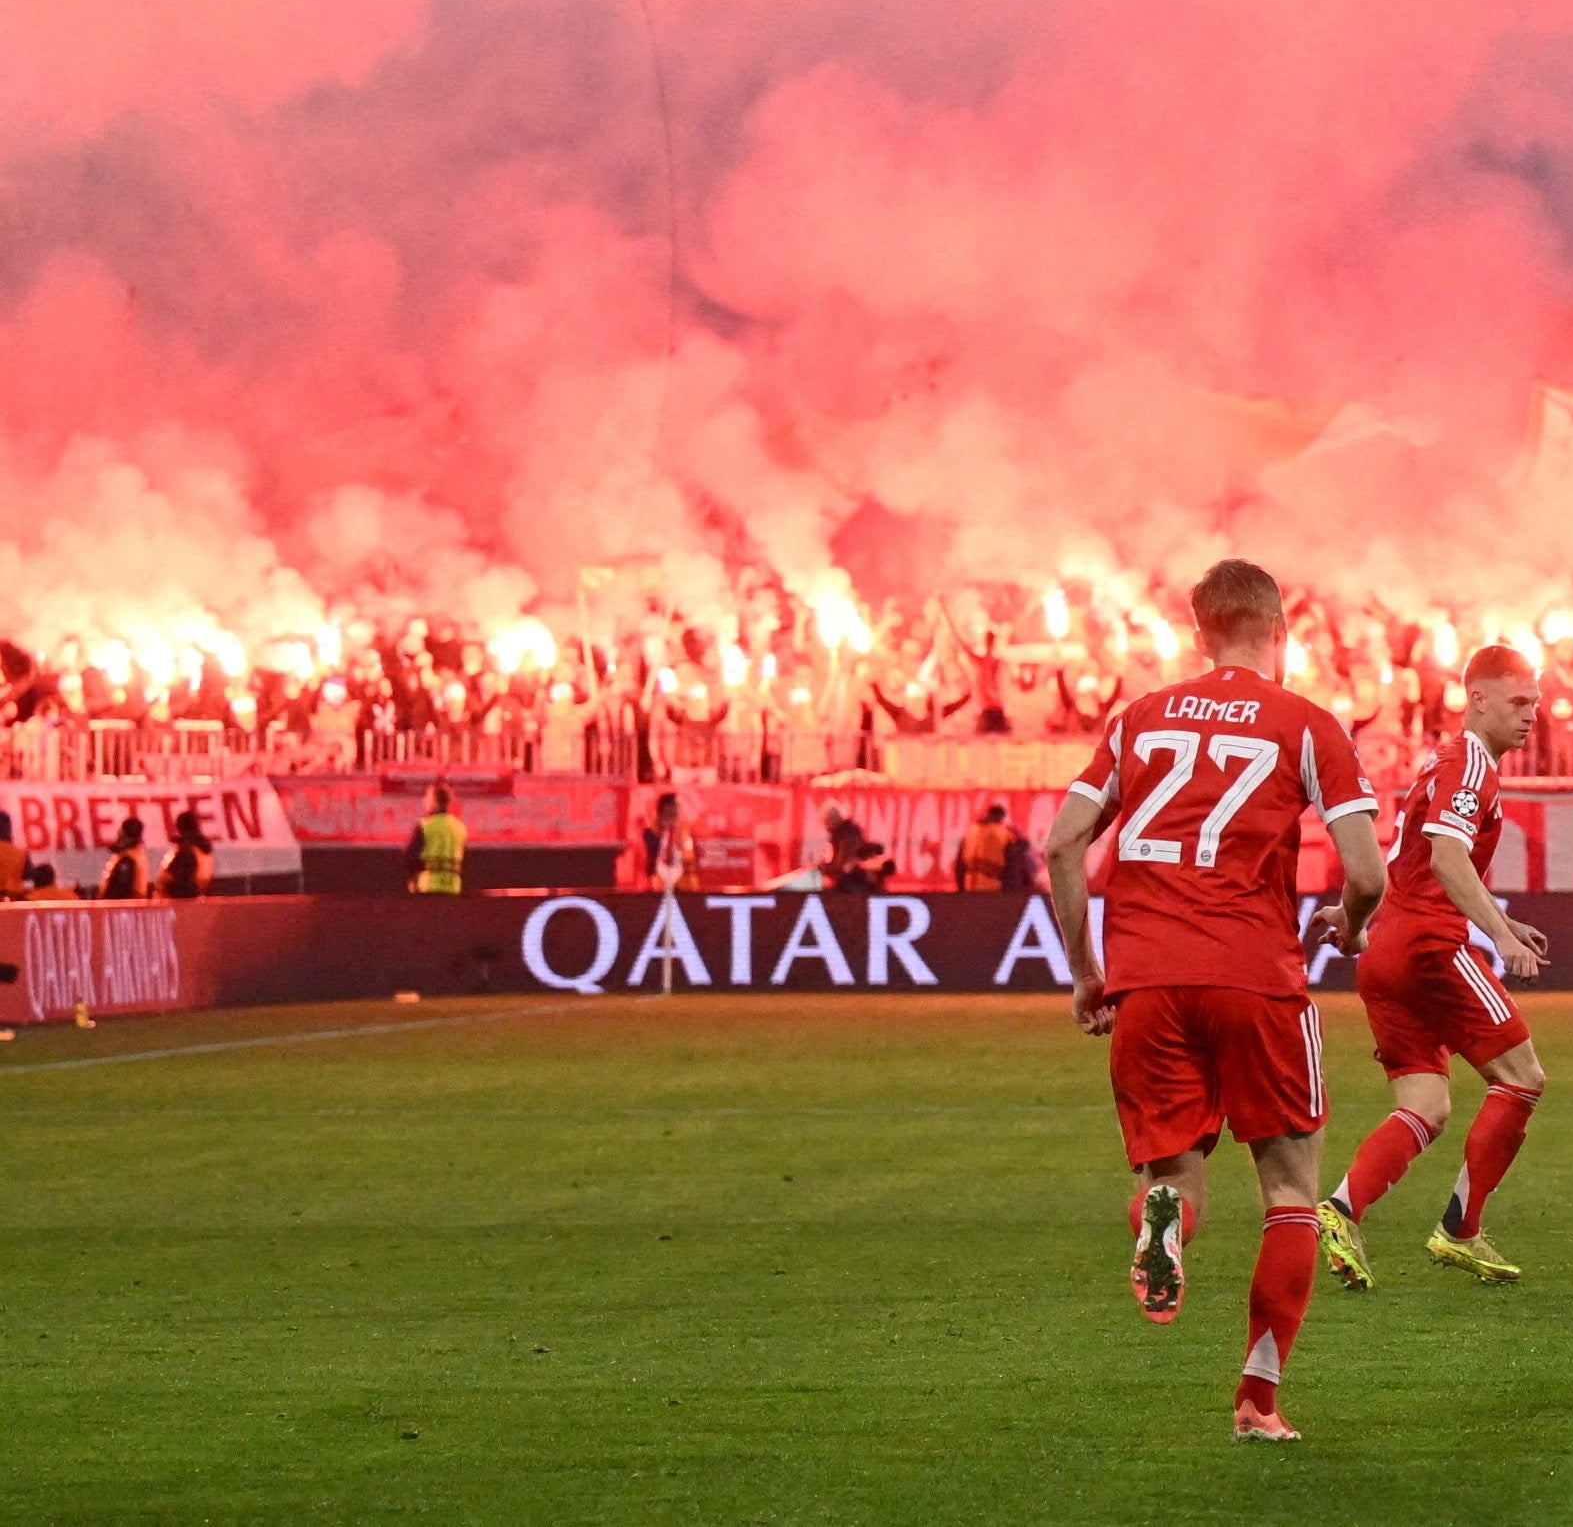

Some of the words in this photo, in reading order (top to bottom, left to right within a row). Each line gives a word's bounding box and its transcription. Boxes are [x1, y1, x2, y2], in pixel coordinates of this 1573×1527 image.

[1164, 695, 1260, 724] LAIMER
[18, 789, 262, 851] BRETTEN
[1119, 730, 1280, 868] 27
[25, 911, 97, 1022] QATAR
[521, 895, 938, 993] QATAR
